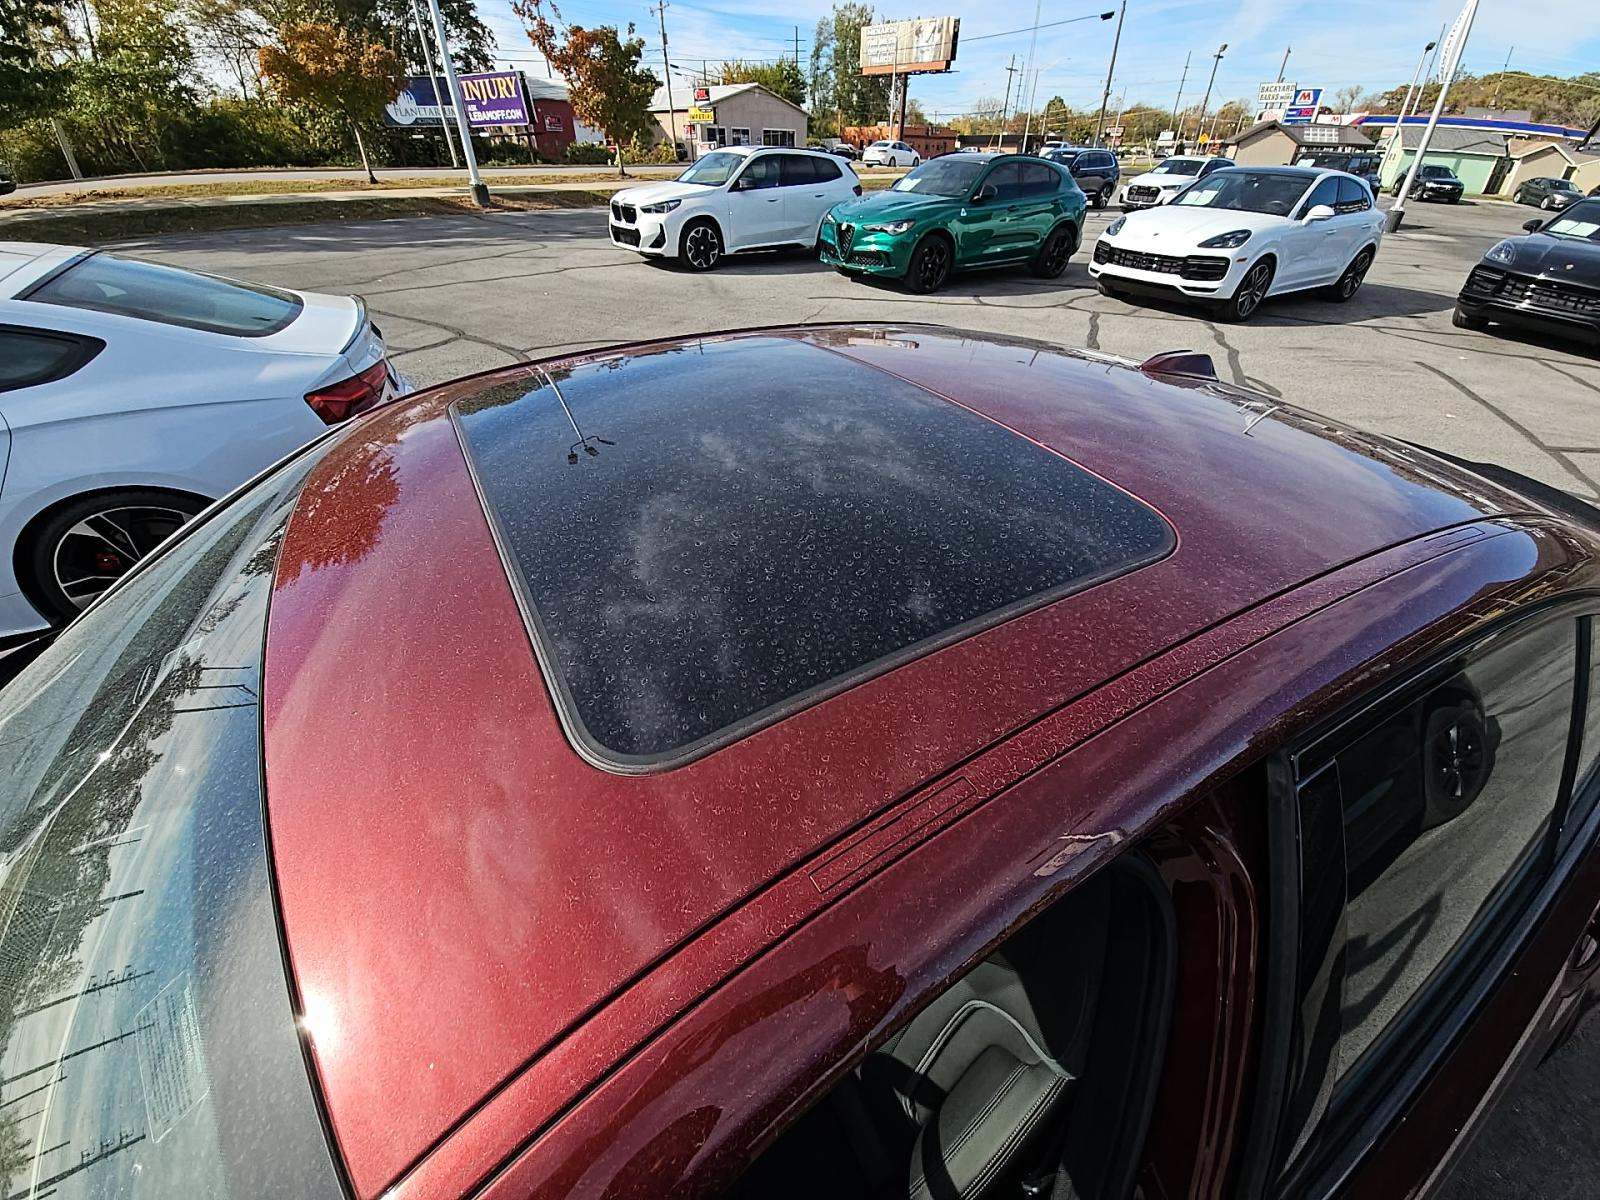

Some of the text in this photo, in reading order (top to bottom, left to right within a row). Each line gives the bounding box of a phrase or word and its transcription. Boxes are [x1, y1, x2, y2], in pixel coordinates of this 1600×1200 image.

[460, 76, 518, 105] INJURY
[1260, 85, 1296, 93] BACKYARD
[468, 108, 523, 122] LEBAMOFF.COM
